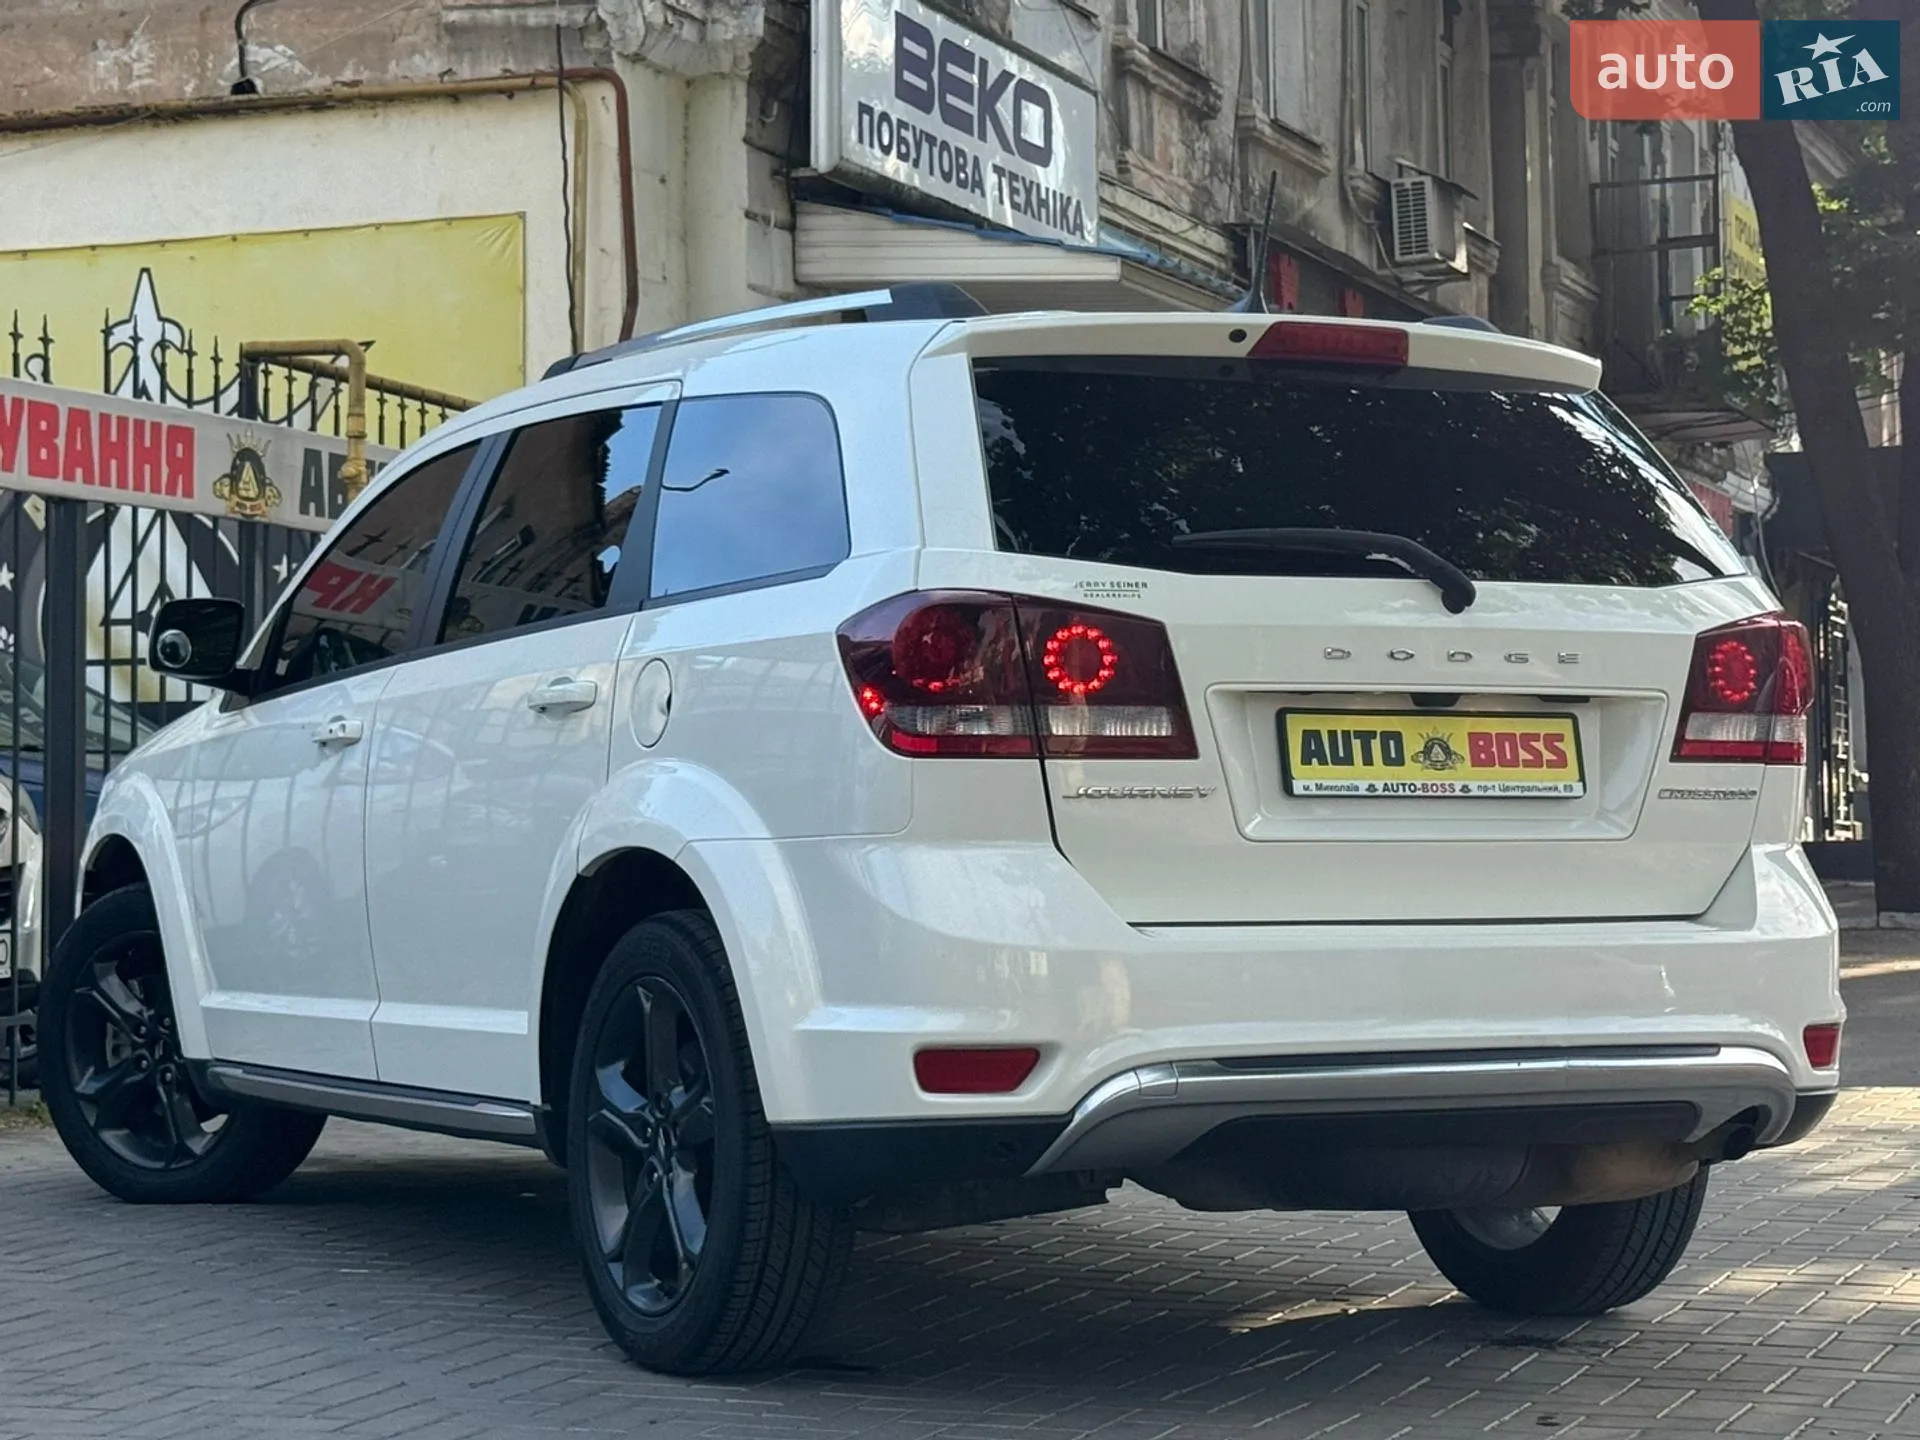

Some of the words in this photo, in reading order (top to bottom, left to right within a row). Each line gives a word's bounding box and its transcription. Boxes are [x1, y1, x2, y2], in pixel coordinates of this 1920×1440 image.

[895, 10, 1052, 168] BEKO
[857, 101, 986, 198] ПОБУТОВА
[992, 163, 1085, 238] ТЕХНІКА
[1324, 646, 1580, 664] DODGE
[1300, 730, 1405, 767] AUTO
[1467, 732, 1568, 769] BOSS
[1382, 783, 1456, 793] AUTO-BOSS
